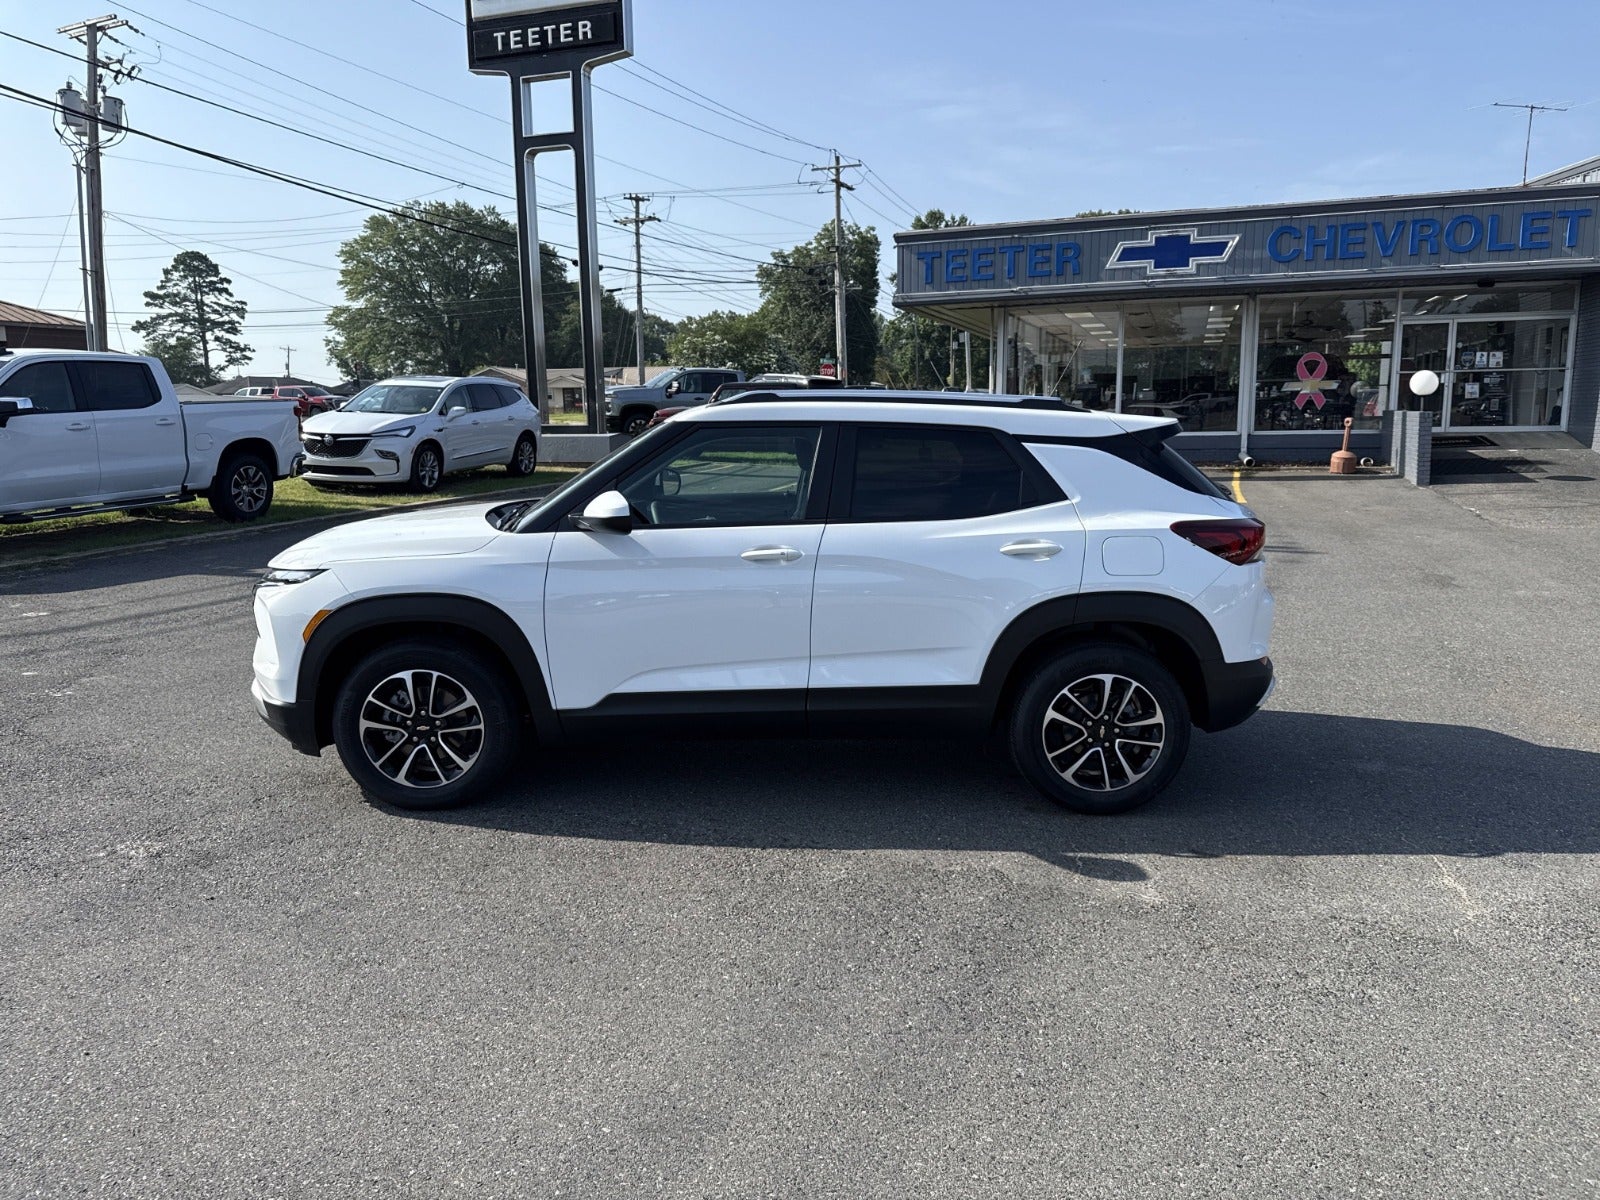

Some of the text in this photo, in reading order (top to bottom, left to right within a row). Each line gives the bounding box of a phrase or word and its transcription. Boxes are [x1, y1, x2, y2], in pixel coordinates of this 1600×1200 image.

[493, 20, 593, 51] TEETER
[916, 208, 1592, 285] TEETER CHEVROLET
